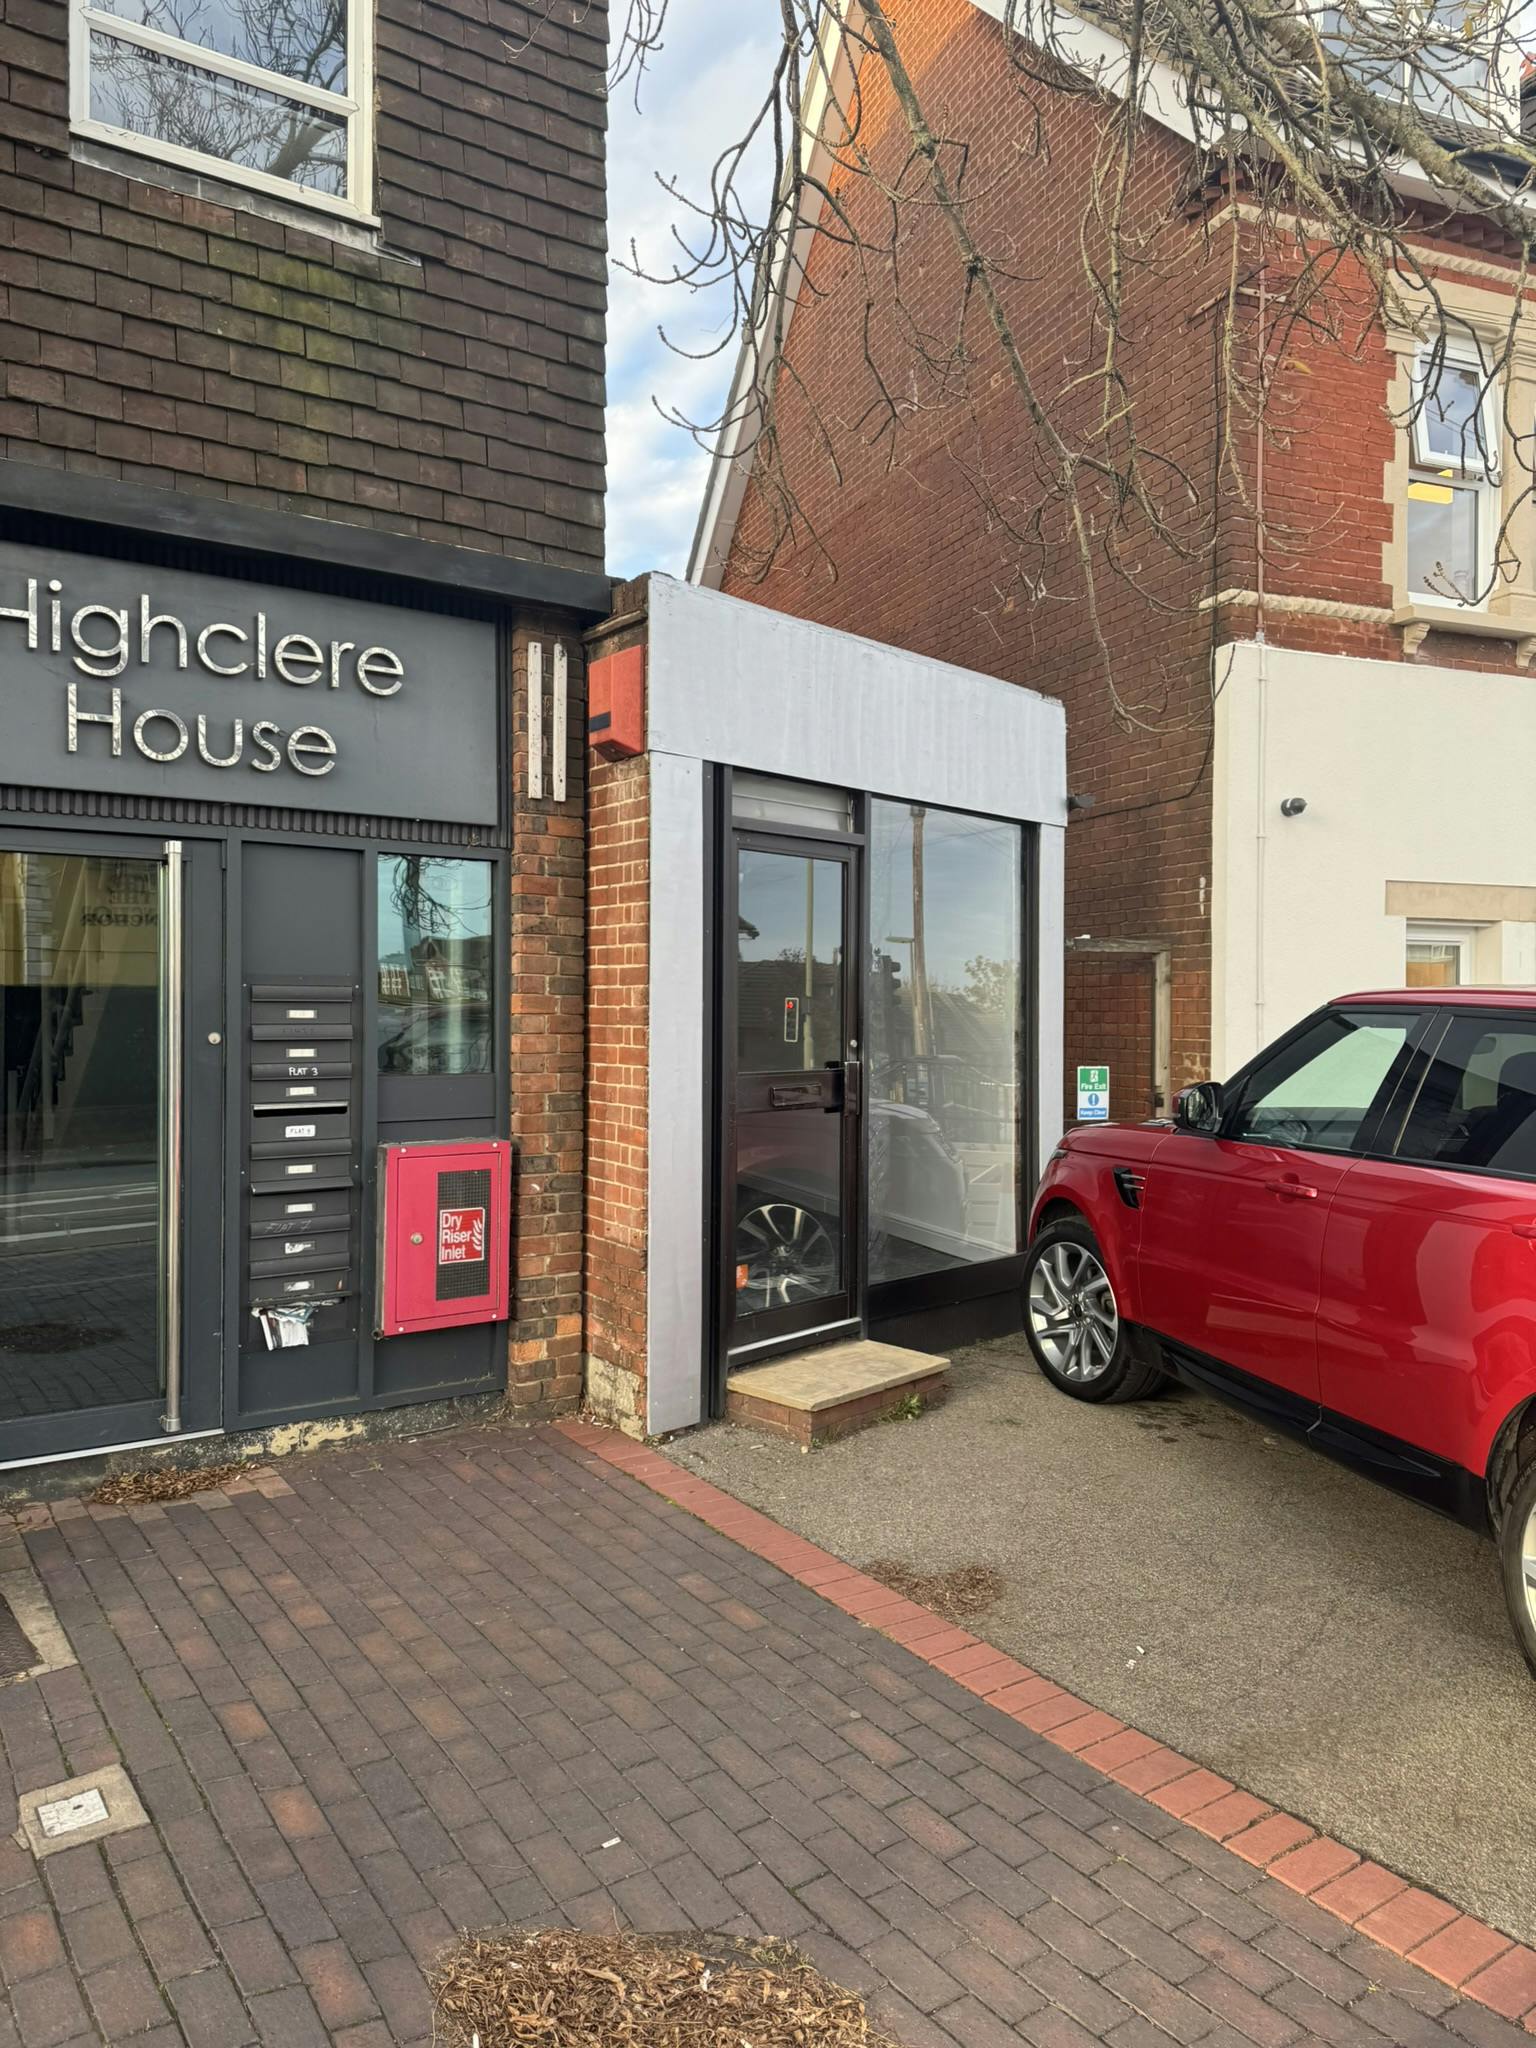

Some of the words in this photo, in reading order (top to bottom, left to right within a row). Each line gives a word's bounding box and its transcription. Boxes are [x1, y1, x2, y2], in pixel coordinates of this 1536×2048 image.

[0, 578, 404, 697] Highclere
[66, 682, 337, 777] House
[288, 1066, 308, 1077] FLAT
[311, 1066, 319, 1077] 3
[442, 1213, 463, 1231] Dry
[442, 1229, 472, 1244] Riser
[441, 1244, 466, 1260] Inlet
